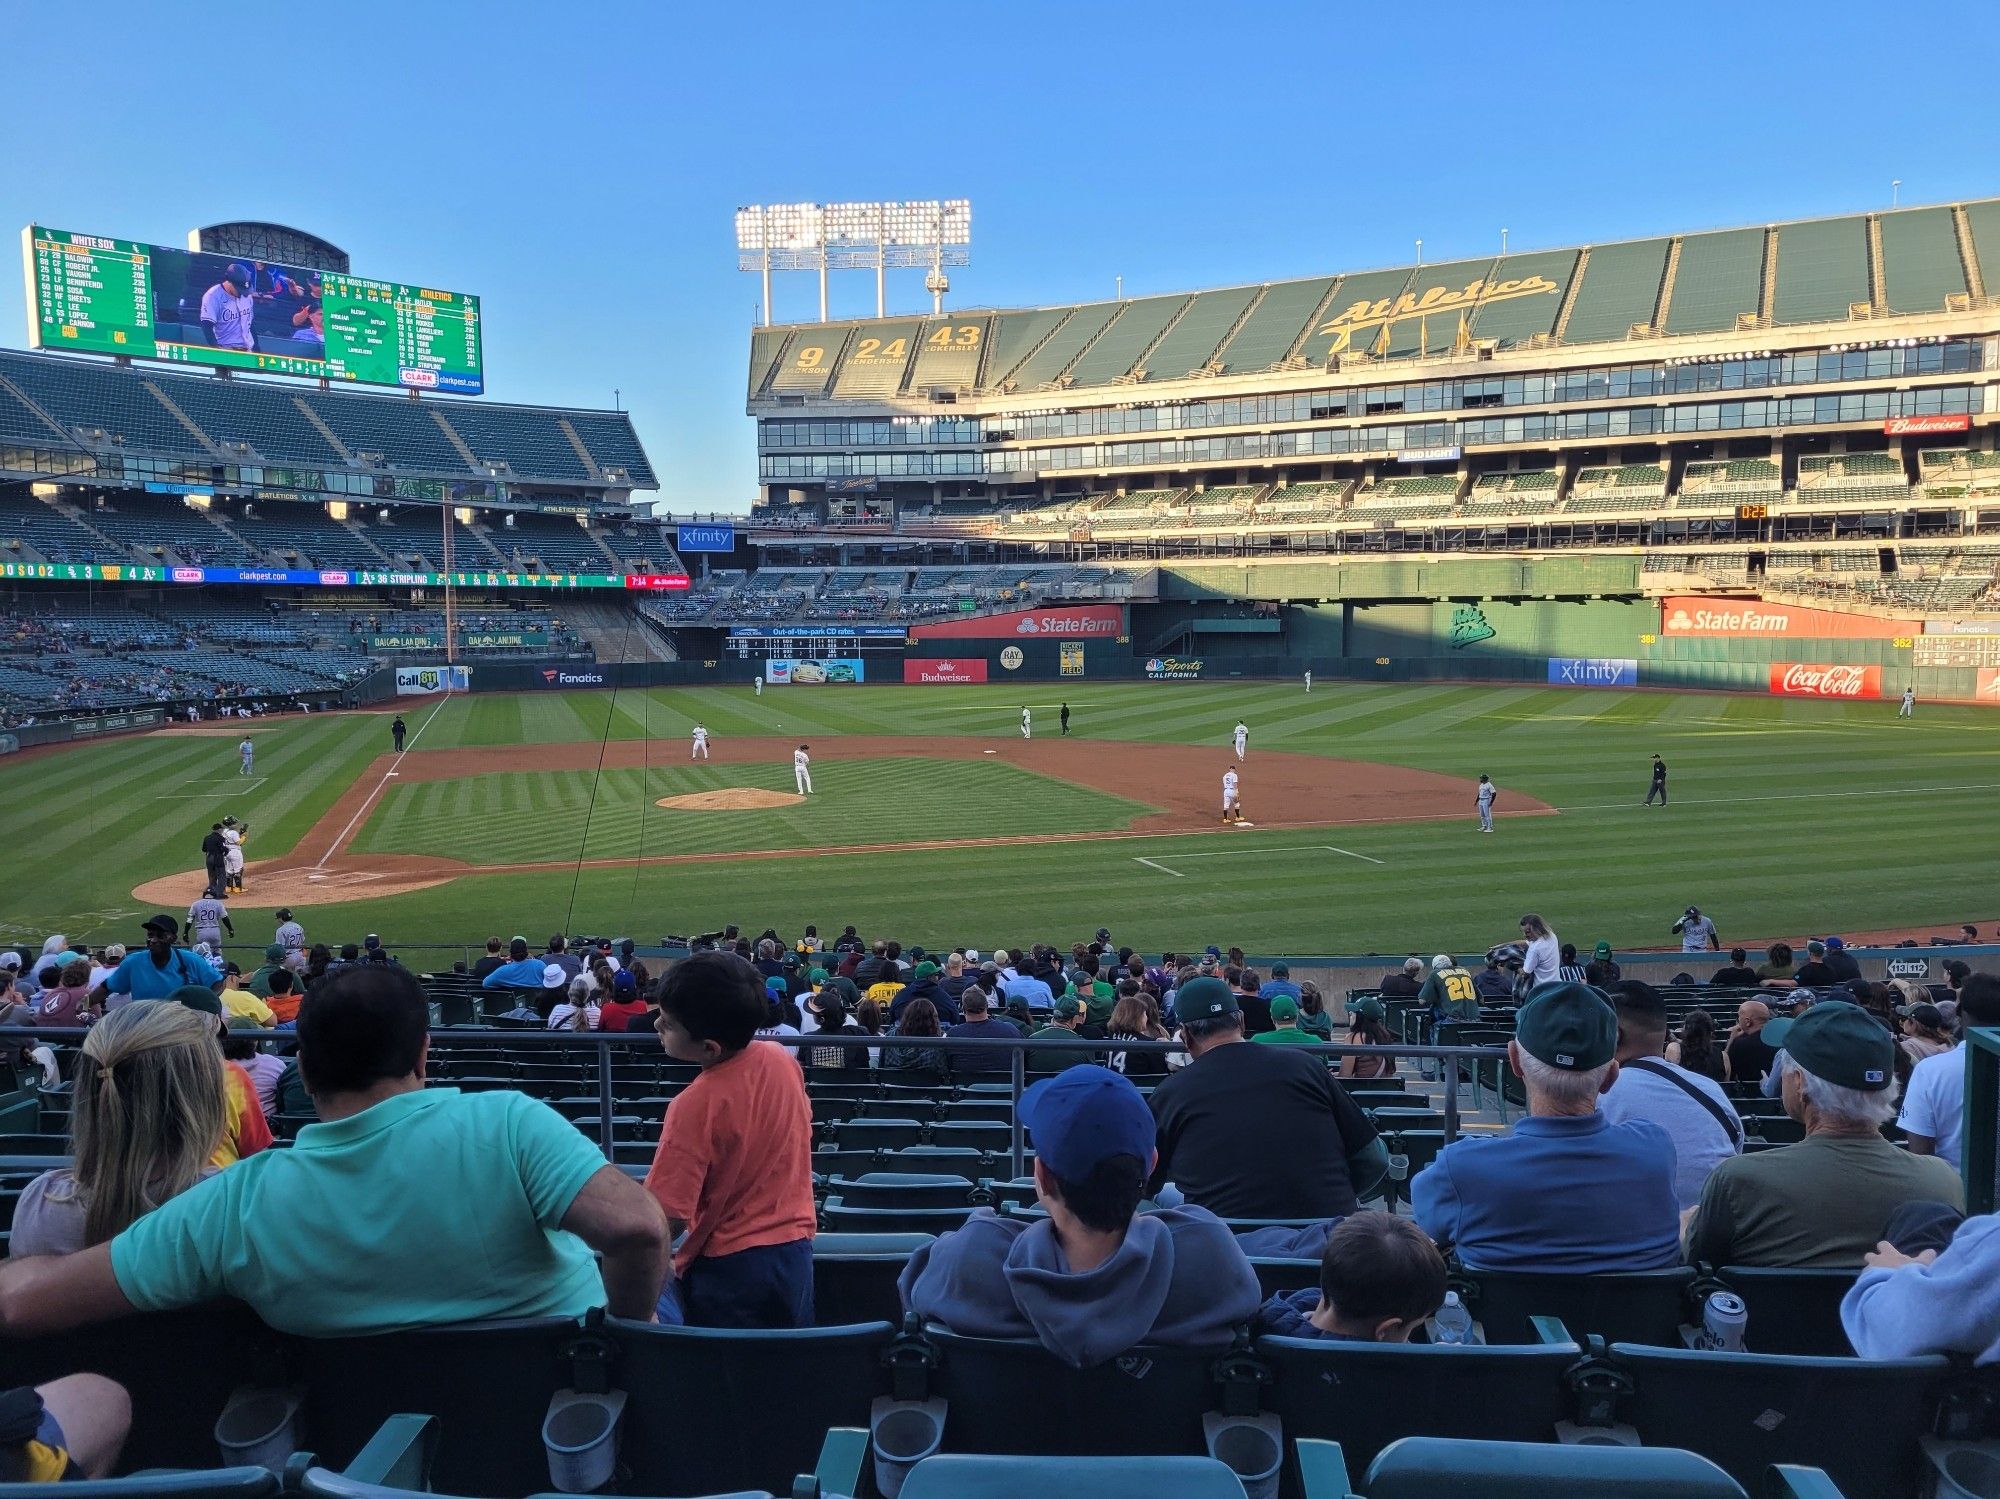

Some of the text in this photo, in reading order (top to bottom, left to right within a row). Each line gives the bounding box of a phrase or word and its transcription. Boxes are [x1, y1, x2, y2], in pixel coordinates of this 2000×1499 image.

[71, 234, 114, 250] WHITE SOX
[64, 254, 93, 264] BALDWIN
[65, 262, 90, 271] ROBERT
[66, 270, 91, 279] VAUGHN
[66, 278, 103, 288] BENINTENDI
[347, 278, 362, 286] ROSS
[362, 281, 391, 292] STRIPLING
[67, 286, 84, 295] SOSA
[420, 289, 452, 302] ATHLETICS
[68, 295, 91, 304] SHEETS
[68, 303, 80, 311] LEE
[1319, 275, 1557, 340] Athletics
[69, 312, 88, 320] LOPEZ
[70, 320, 95, 328] CANNON
[928, 326, 980, 346] 43
[855, 338, 906, 359] 24
[797, 347, 824, 368] 9
[405, 372, 433, 382] CLARK
[440, 376, 480, 388] clarkpest.com
[1889, 416, 1966, 433] Budweiser
[1404, 449, 1454, 459] BUD LIGHT
[165, 484, 195, 493] Corona
[683, 528, 730, 548] xfinity
[48, 566, 54, 577] 2
[85, 566, 92, 578] 3
[129, 568, 136, 579] 4
[240, 572, 286, 581] clarkpest.com
[378, 574, 388, 584] 36
[390, 574, 428, 584] STRIPLING
[904, 638, 919, 646] 362
[1893, 638, 1912, 648] 362
[1004, 650, 1020, 660] RAY
[458, 666, 474, 674] 30
[1164, 658, 1203, 672] Sports
[560, 672, 602, 684] Fanatics
[1562, 661, 1623, 684] xfinity
[398, 672, 438, 686] Call 811
[1782, 664, 1866, 696] Coca-Cola
[201, 910, 215, 920] 20
[290, 933, 302, 947] 27
[1892, 964, 1924, 972] 113 112
[1445, 976, 1476, 1002] 20
[1107, 1050, 1128, 1074] 14
